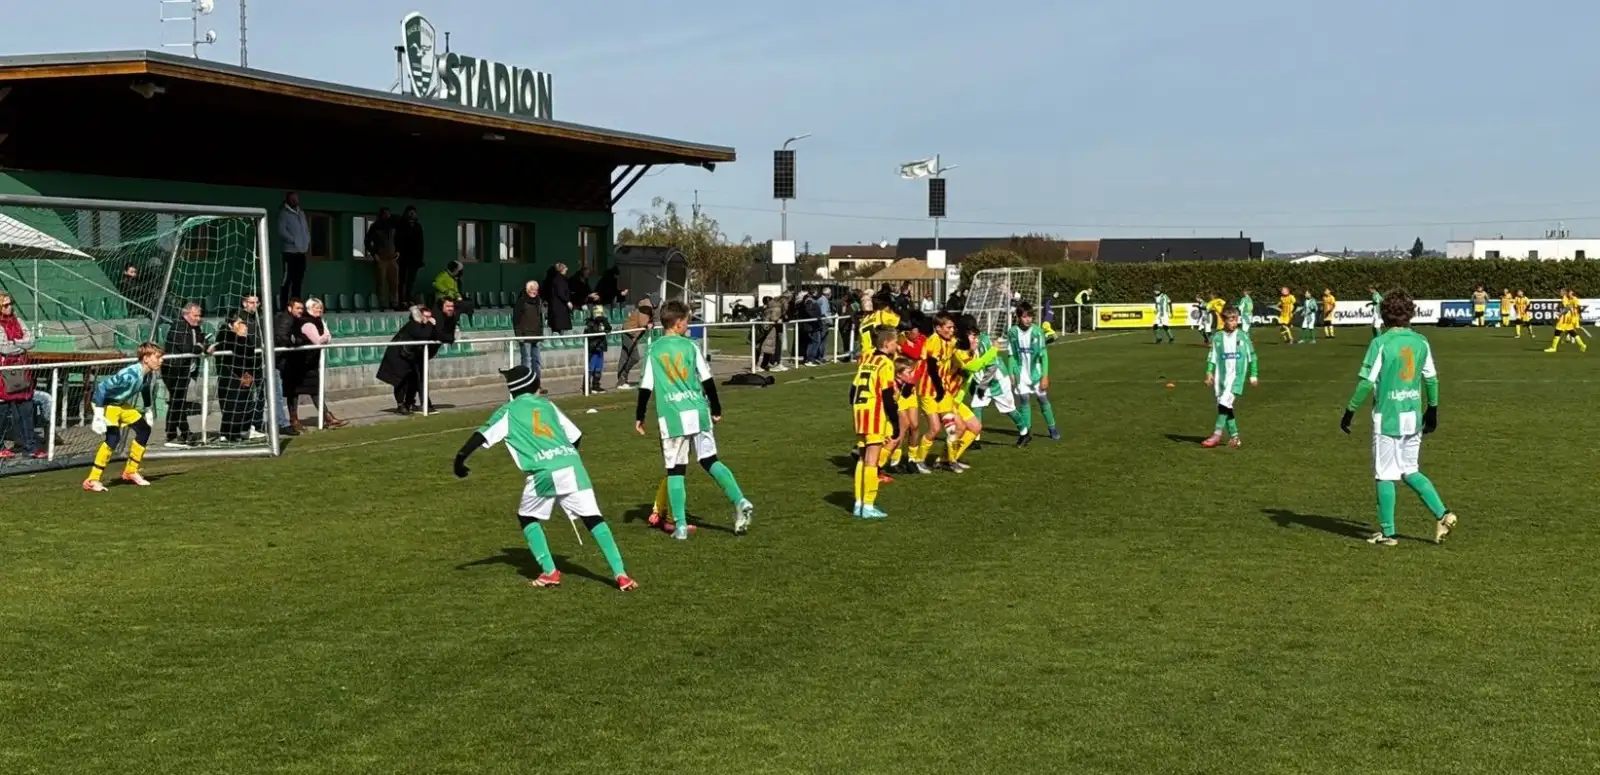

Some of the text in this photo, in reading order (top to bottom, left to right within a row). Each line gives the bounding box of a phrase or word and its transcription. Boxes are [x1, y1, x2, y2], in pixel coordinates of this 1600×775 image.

[441, 52, 553, 120] STADION
[1400, 347, 1415, 381] 3
[532, 408, 555, 440] 4
